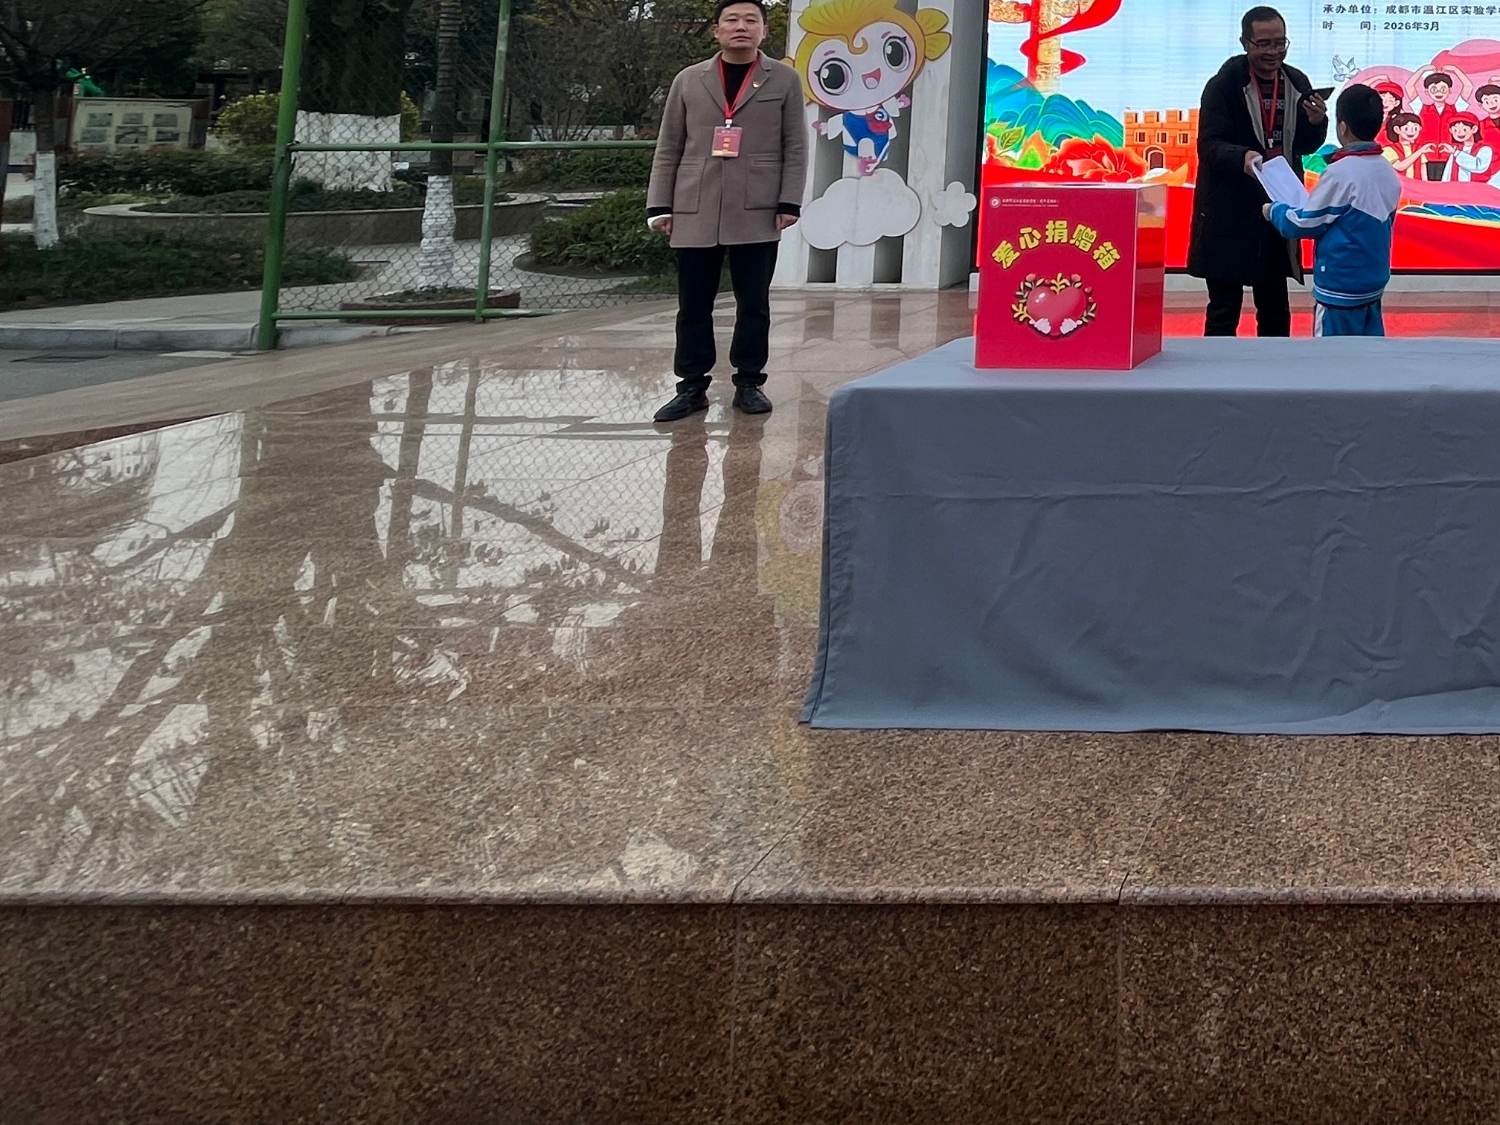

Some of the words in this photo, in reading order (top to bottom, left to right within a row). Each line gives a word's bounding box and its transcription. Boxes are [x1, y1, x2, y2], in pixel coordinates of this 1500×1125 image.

[991, 220, 1121, 270] 爱心捐赠箱
